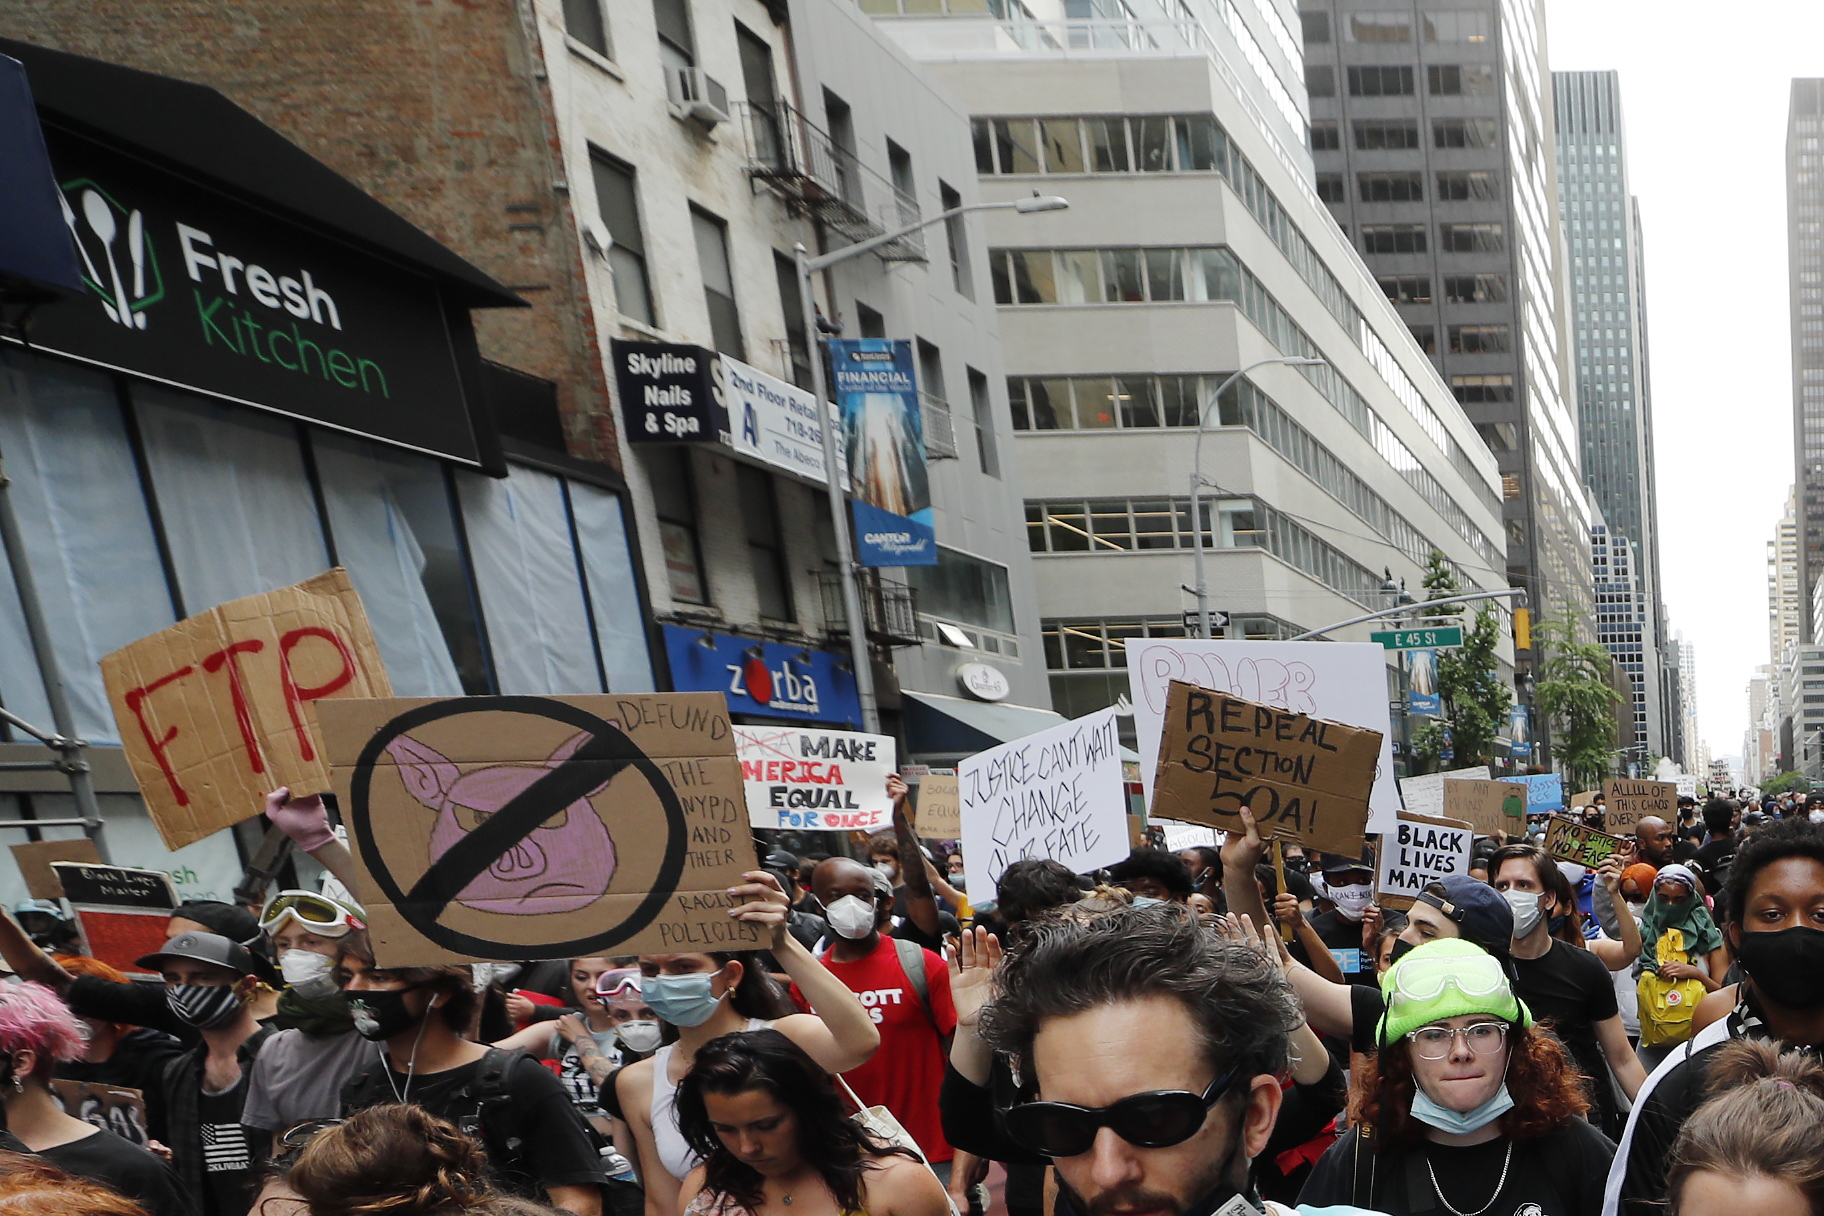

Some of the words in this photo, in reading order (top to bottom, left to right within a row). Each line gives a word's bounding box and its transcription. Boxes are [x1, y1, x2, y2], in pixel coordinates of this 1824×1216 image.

[176, 221, 343, 331] Fresh
[193, 289, 390, 399] Kitchen
[627, 353, 696, 380] Skyline
[837, 371, 911, 383] FINANCIAL
[644, 385, 692, 406] Nails
[730, 370, 754, 395] 2nd
[757, 382, 785, 407] Floor
[645, 412, 659, 433] &
[664, 412, 699, 438] Spa
[773, 440, 790, 458] The
[864, 532, 911, 544] CANTOR
[1395, 633, 1402, 645] E
[1406, 632, 1421, 645] 45
[1424, 630, 1437, 645] St
[125, 626, 357, 807] FTP
[617, 699, 728, 741] DEFUND
[1186, 691, 1338, 753] REPEAL
[800, 735, 877, 762] MAKE
[964, 744, 1035, 808] JUSTICE
[1038, 725, 1083, 780] CANT
[1082, 714, 1114, 772] WAIT
[1182, 734, 1316, 785] SECTION
[661, 757, 714, 788] THE
[770, 786, 860, 810] EQUAL
[1209, 775, 1318, 833] 50A!
[1651, 785, 1667, 798] OF
[682, 797, 737, 823] NYPD
[992, 772, 1088, 847] CHANGE
[1615, 799, 1636, 811] THIS
[1641, 799, 1669, 811] CHAOS
[778, 811, 818, 828] FOR
[823, 810, 882, 828] ONCE
[1609, 812, 1636, 826] OVER
[691, 827, 732, 844] AND
[1044, 813, 1100, 862] FATE
[1397, 824, 1463, 853] BLACK
[1553, 823, 1580, 838] NO
[1583, 825, 1618, 848] JUSTICE
[685, 849, 736, 869] THEIR
[1400, 848, 1455, 873] LIVES
[1553, 840, 1572, 854] NO
[1574, 842, 1612, 864] PEACE
[80, 867, 118, 882] Black
[120, 870, 160, 888] Lives
[100, 885, 151, 897] Matter
[659, 923, 760, 947] POLICIES
